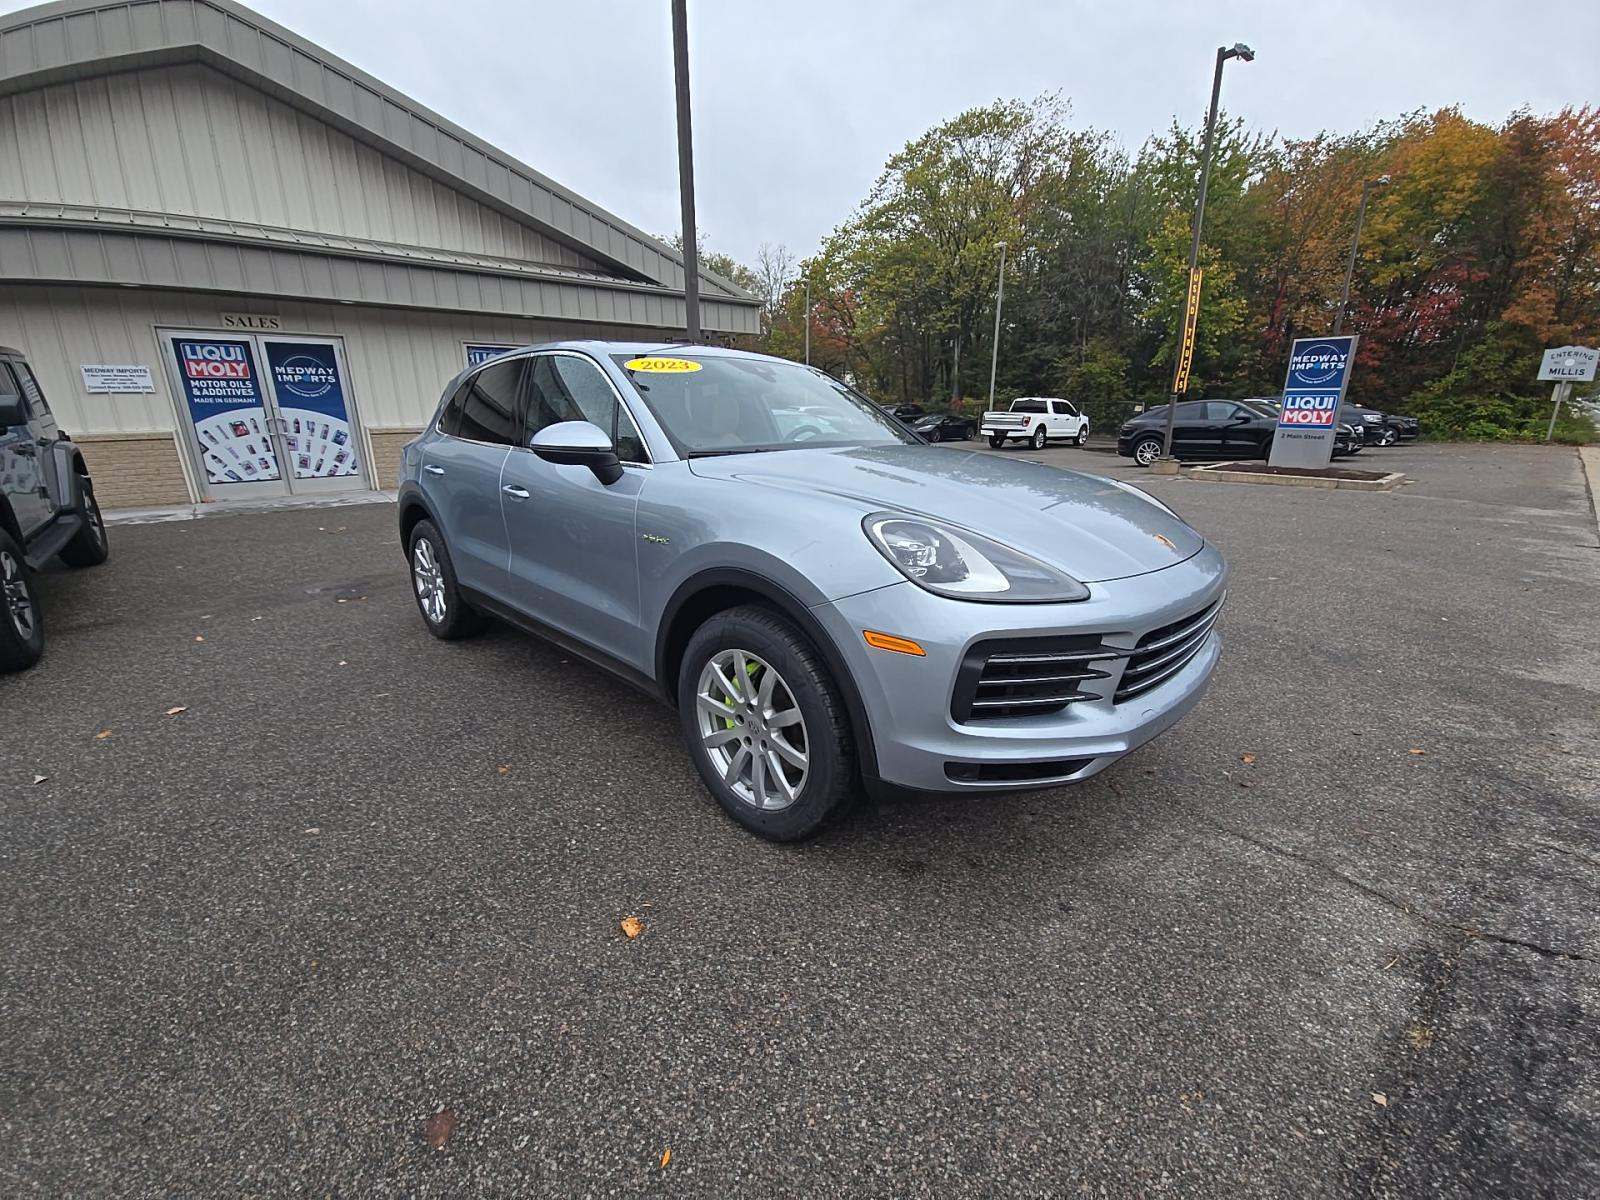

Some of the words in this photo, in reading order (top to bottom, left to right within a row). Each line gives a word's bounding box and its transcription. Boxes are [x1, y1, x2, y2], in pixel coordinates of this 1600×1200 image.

[1190, 274, 1199, 314] USED
[224, 315, 279, 329] SALES
[184, 345, 243, 361] LIQUI
[1550, 351, 1594, 361] ENTERING
[1293, 354, 1347, 363] MEDWAY
[188, 361, 246, 377] MOLY
[641, 360, 690, 370] 2023
[275, 366, 334, 375] MEDWAY
[1549, 368, 1586, 376] MILLIS
[190, 380, 228, 388] MOTOR
[229, 380, 253, 388] OILS
[192, 388, 201, 396] &
[202, 388, 254, 396] ADDITIVES
[1286, 397, 1335, 410] LIQUI
[1283, 410, 1333, 423] MOLY
